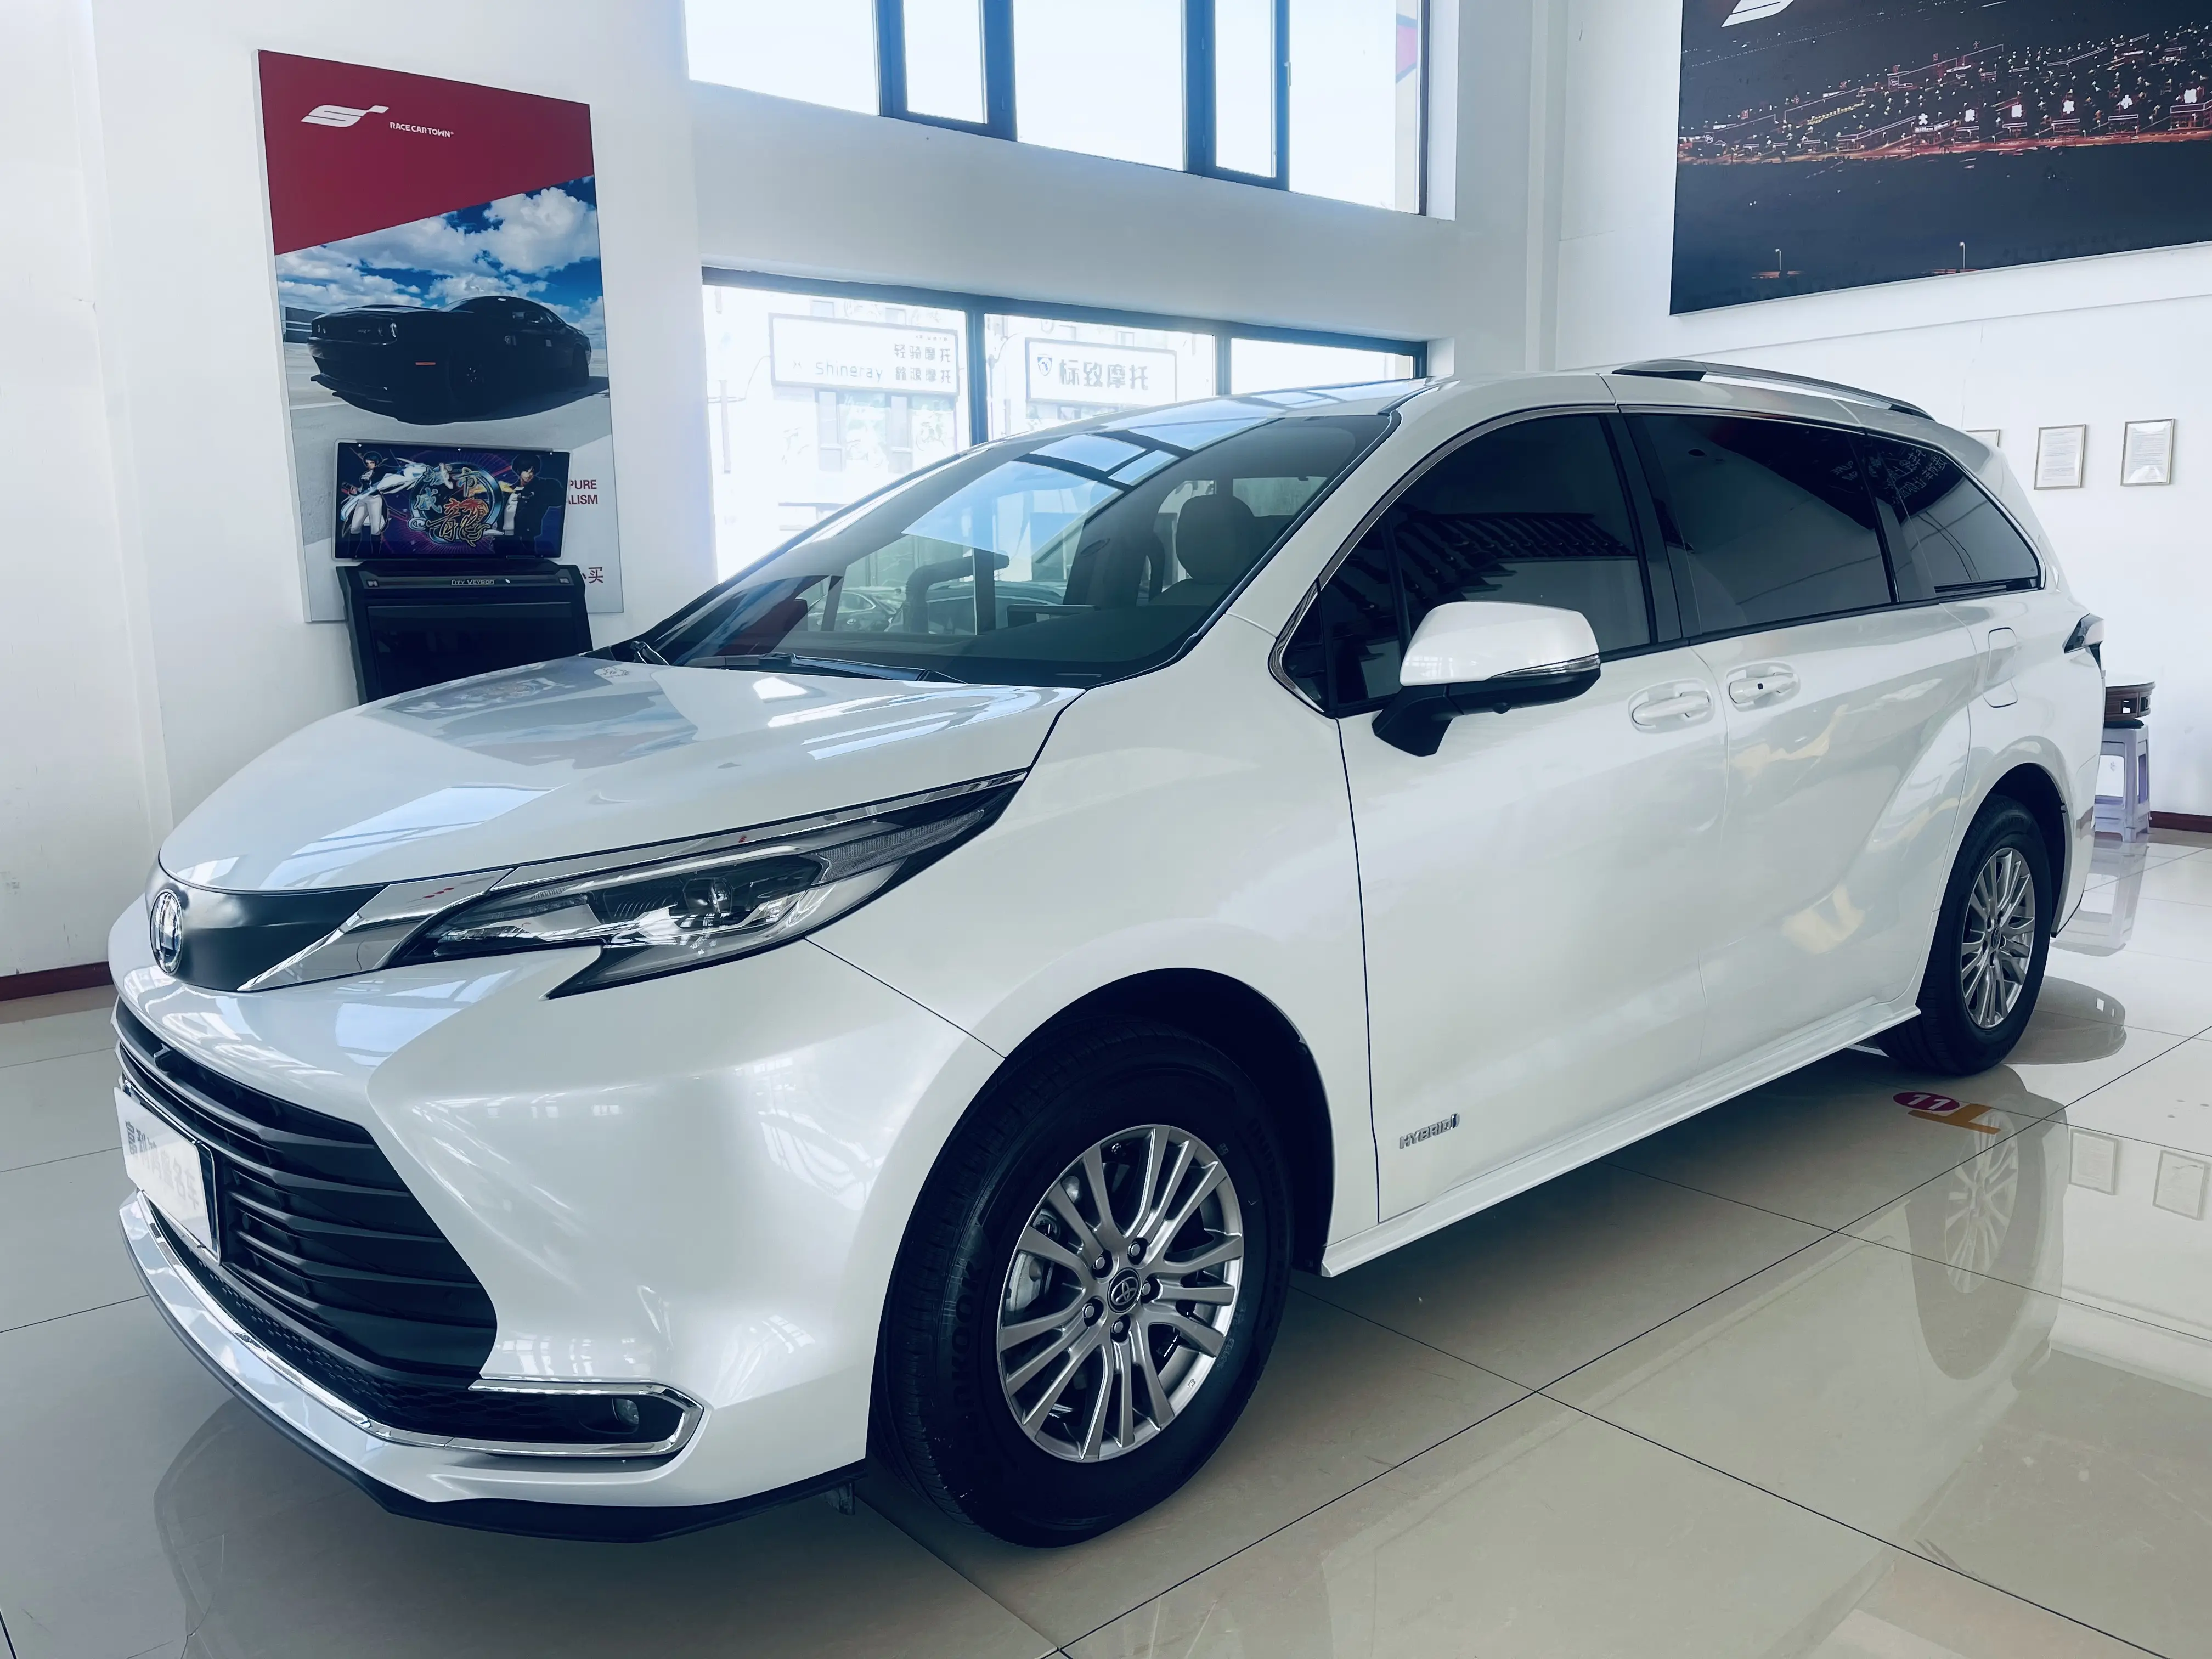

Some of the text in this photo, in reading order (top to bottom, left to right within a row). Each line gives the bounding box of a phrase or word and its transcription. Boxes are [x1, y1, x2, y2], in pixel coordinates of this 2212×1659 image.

[894, 344, 951, 363] 轻骑摩托
[815, 360, 882, 383] Shineray
[1059, 359, 1148, 390] 标致摩托
[568, 494, 598, 505] LISM
[1907, 1094, 1951, 1110] 11
[1399, 1118, 1452, 1150] HYBRID
